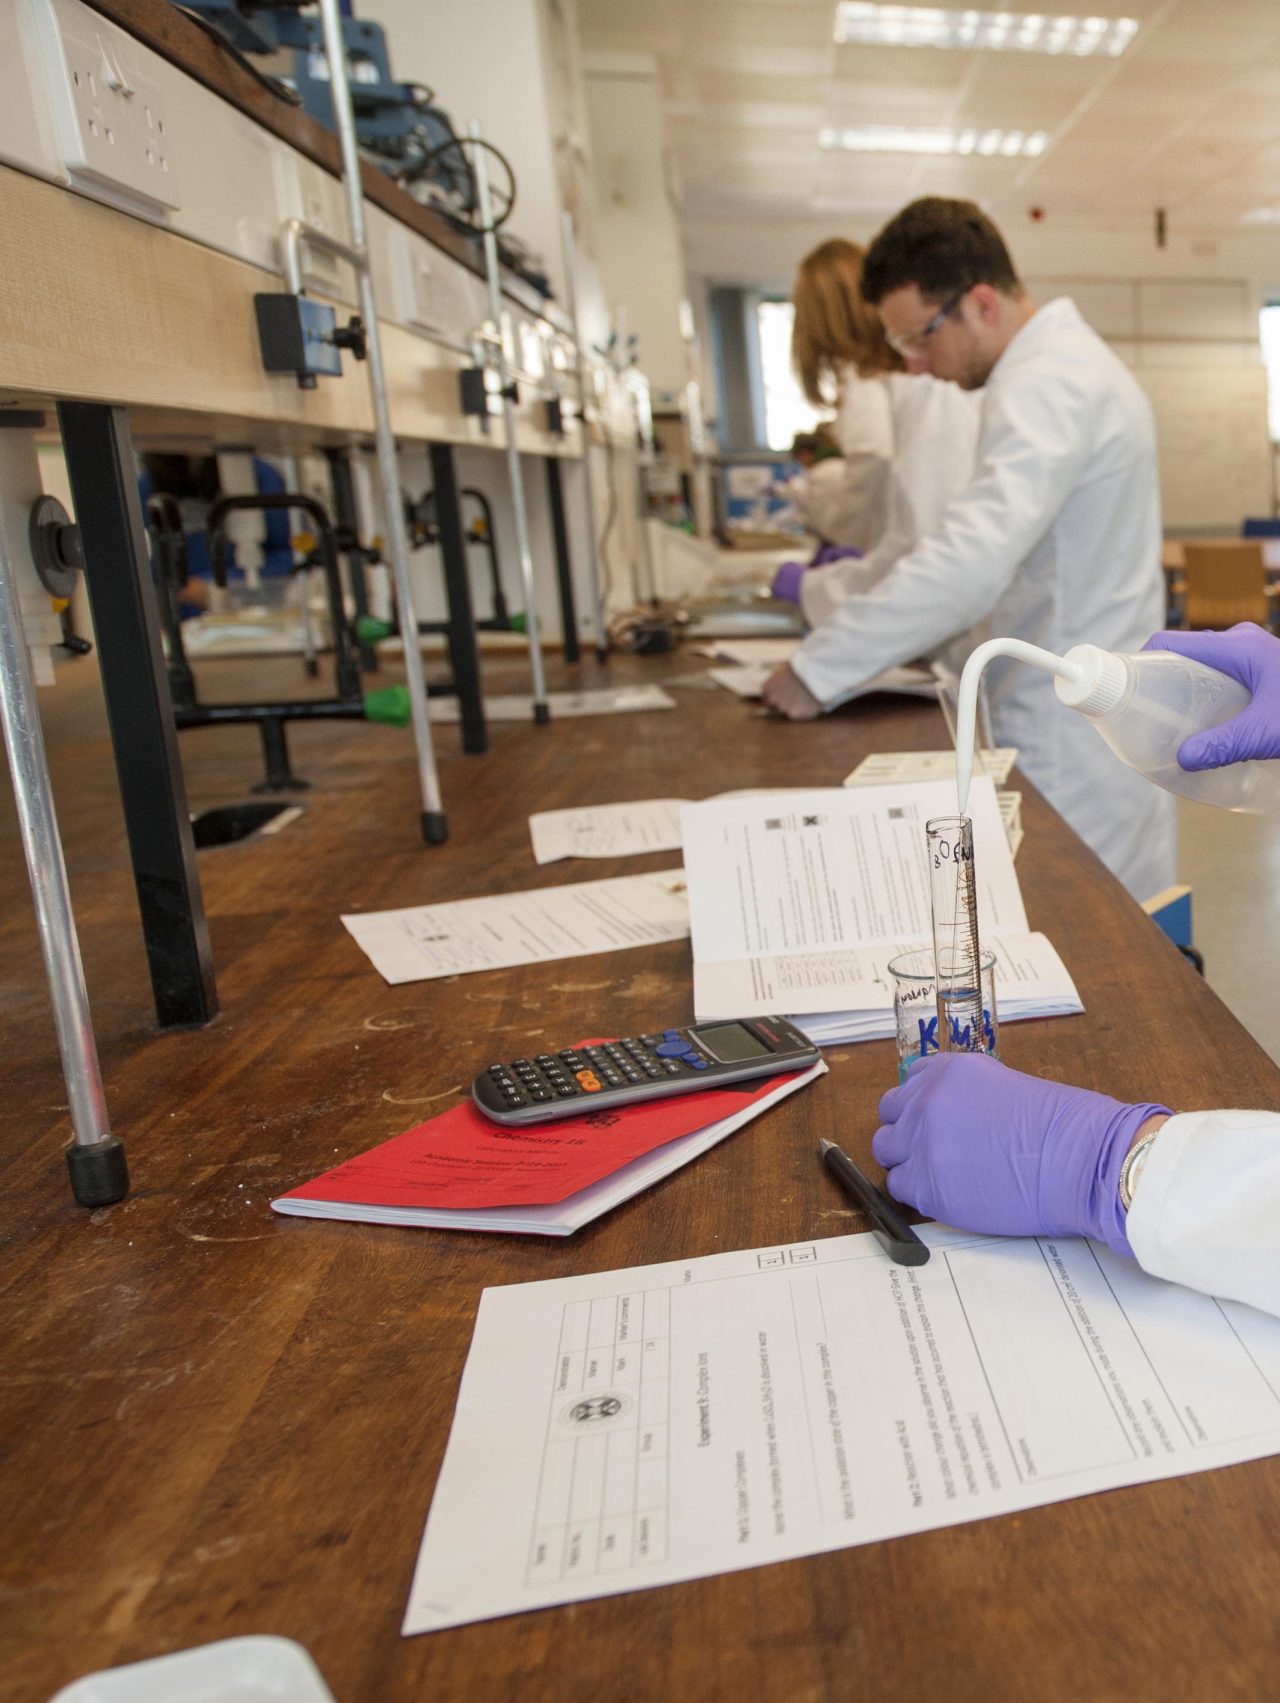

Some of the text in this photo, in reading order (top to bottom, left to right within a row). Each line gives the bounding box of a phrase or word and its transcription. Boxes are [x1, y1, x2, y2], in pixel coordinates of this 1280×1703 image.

[1046, 1243, 1058, 1257] water
[887, 1269, 896, 1277] the
[1053, 1258, 1069, 1280] deionised
[890, 1278, 899, 1288] Give
[696, 1366, 710, 1395] Complex
[696, 1404, 711, 1448] Experiment
